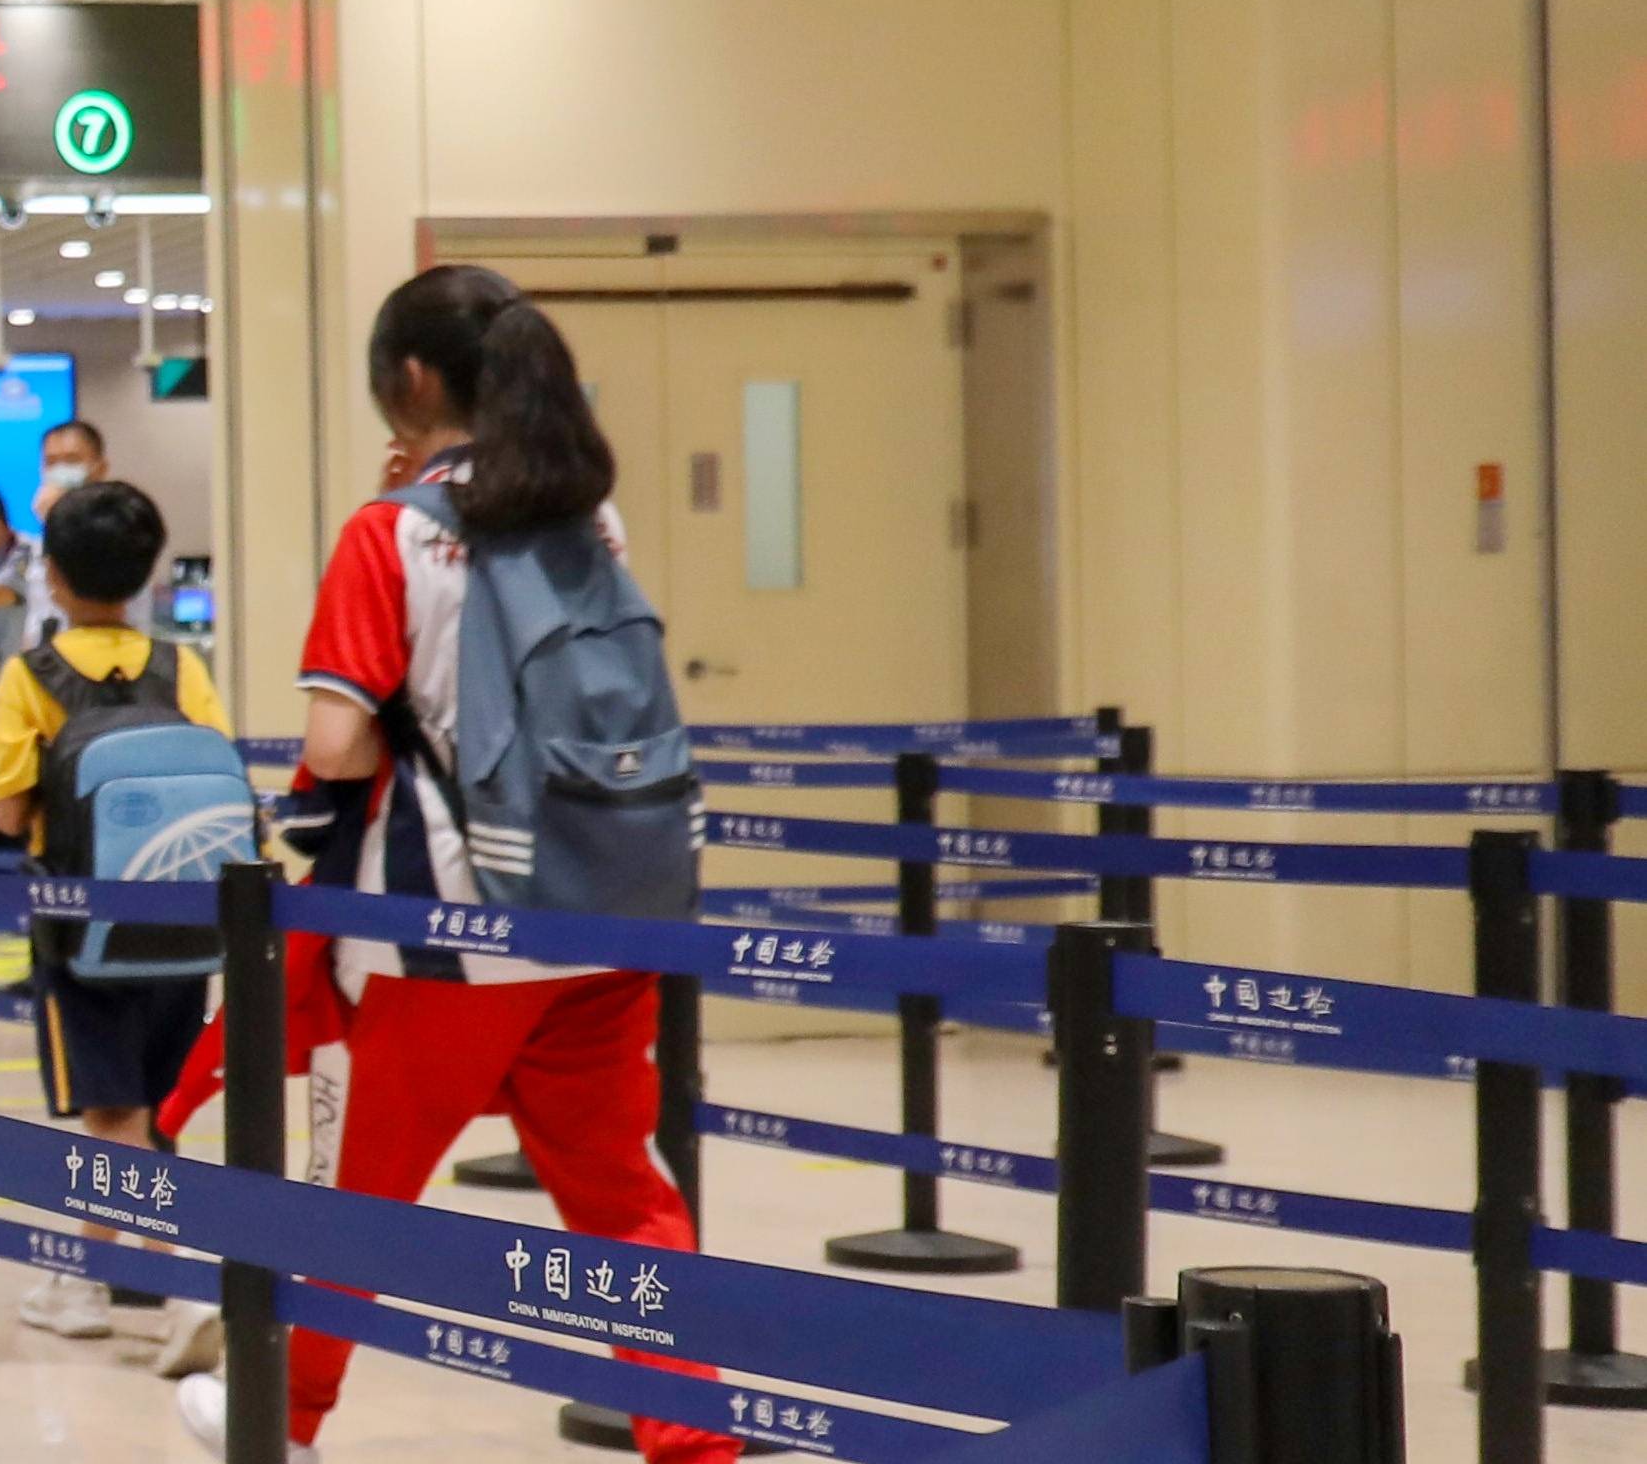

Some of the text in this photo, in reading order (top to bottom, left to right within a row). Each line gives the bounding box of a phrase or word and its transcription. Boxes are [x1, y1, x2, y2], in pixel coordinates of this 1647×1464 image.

[426, 908, 513, 941] 中国边检
[730, 933, 837, 969] 中国边检
[1203, 974, 1336, 1018] 中国边检
[65, 1145, 178, 1211] 中国边检
[505, 1238, 670, 1318] 中国边检
[426, 1323, 512, 1366] 中国边检
[508, 1300, 674, 1346] CHINA IMMIGRATION INSPECTION
[728, 1391, 835, 1438] 中国边检
